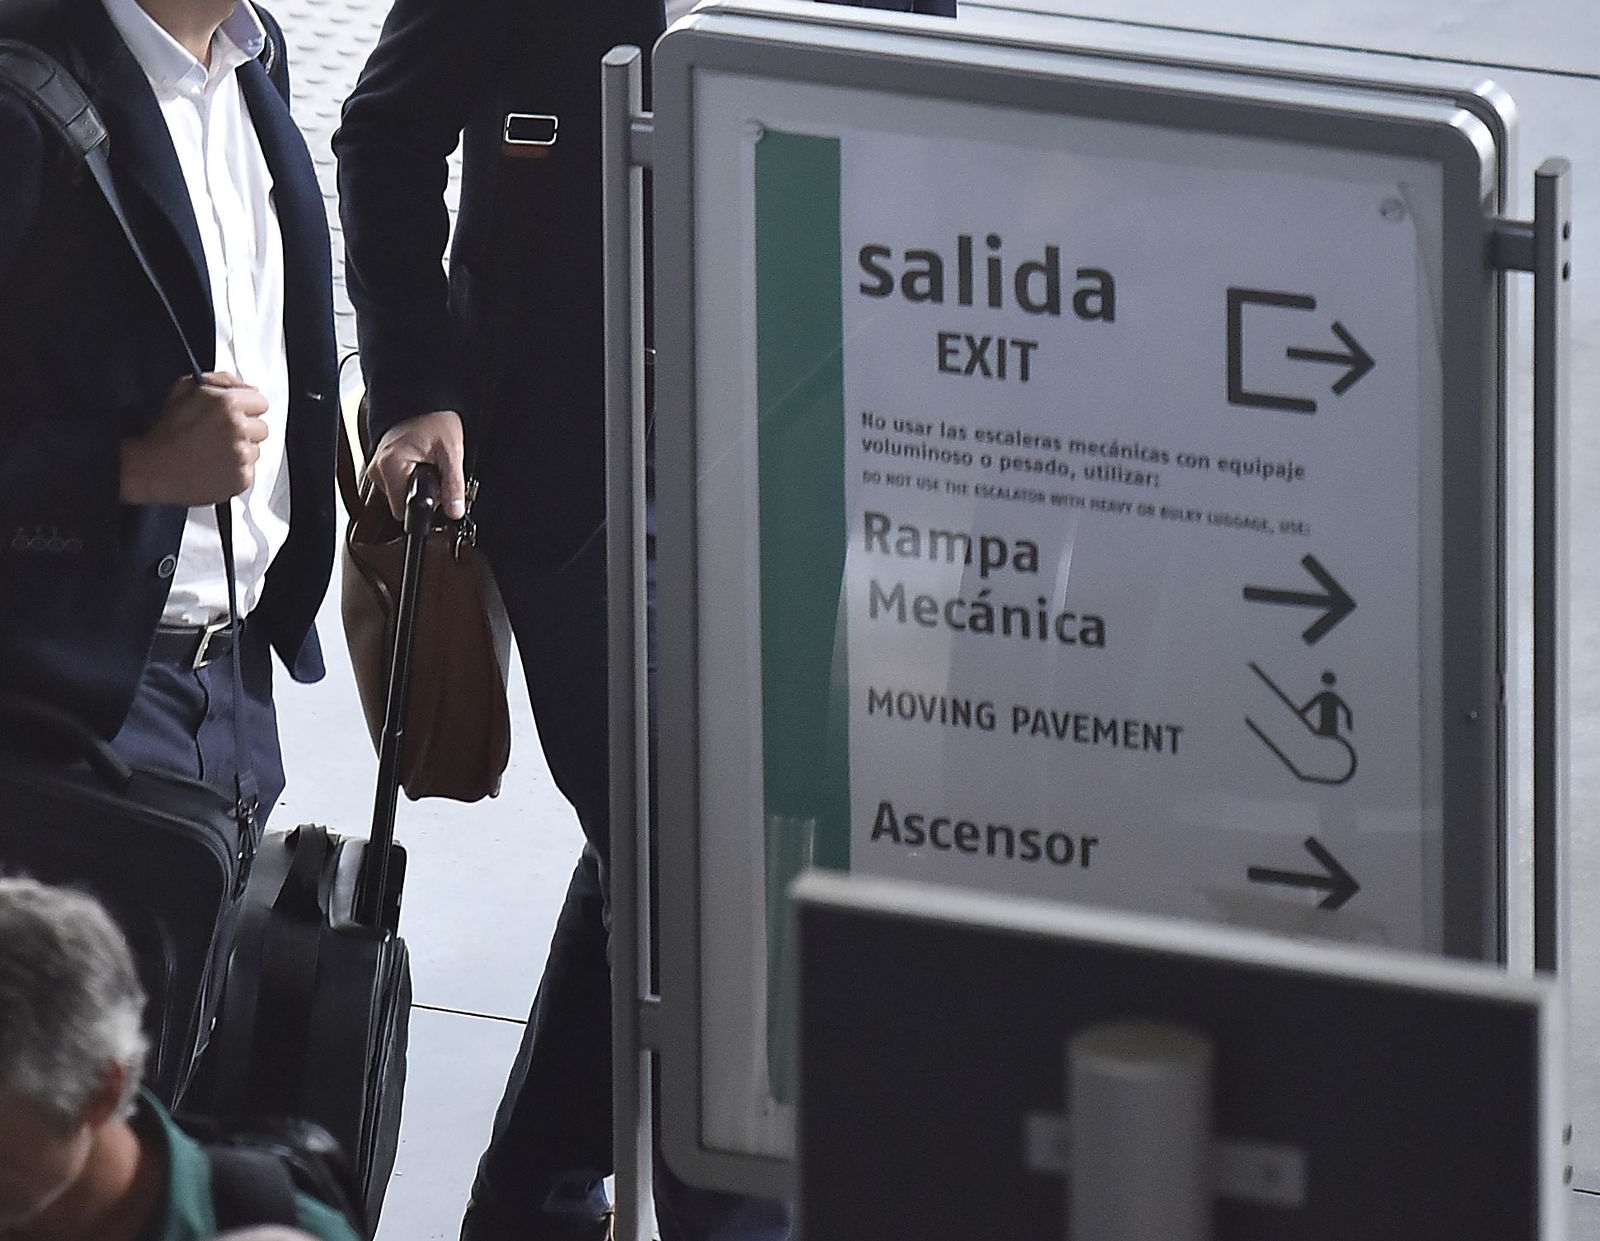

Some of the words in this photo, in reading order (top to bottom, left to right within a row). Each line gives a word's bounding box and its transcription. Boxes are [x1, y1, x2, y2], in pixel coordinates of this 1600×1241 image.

[857, 233, 1117, 324] salida
[936, 331, 1040, 383] EXIT
[861, 411, 886, 431] No
[893, 418, 933, 437] usar
[940, 420, 968, 442] las
[974, 427, 1062, 452] escaleras
[1068, 437, 1170, 466] mecánicas
[1176, 451, 1211, 472] con
[1217, 456, 1306, 483] equipaje
[861, 436, 974, 467] voluminoso
[980, 453, 992, 469] o
[1000, 455, 1076, 482] pesado,
[862, 470, 881, 485] DO
[886, 472, 912, 489] NOT
[862, 510, 1040, 578] Rampa
[867, 578, 1107, 649] Mecánica
[866, 686, 997, 731] MOVING
[1012, 703, 1185, 756] PAVEMENT
[869, 799, 1101, 869] Ascensor
